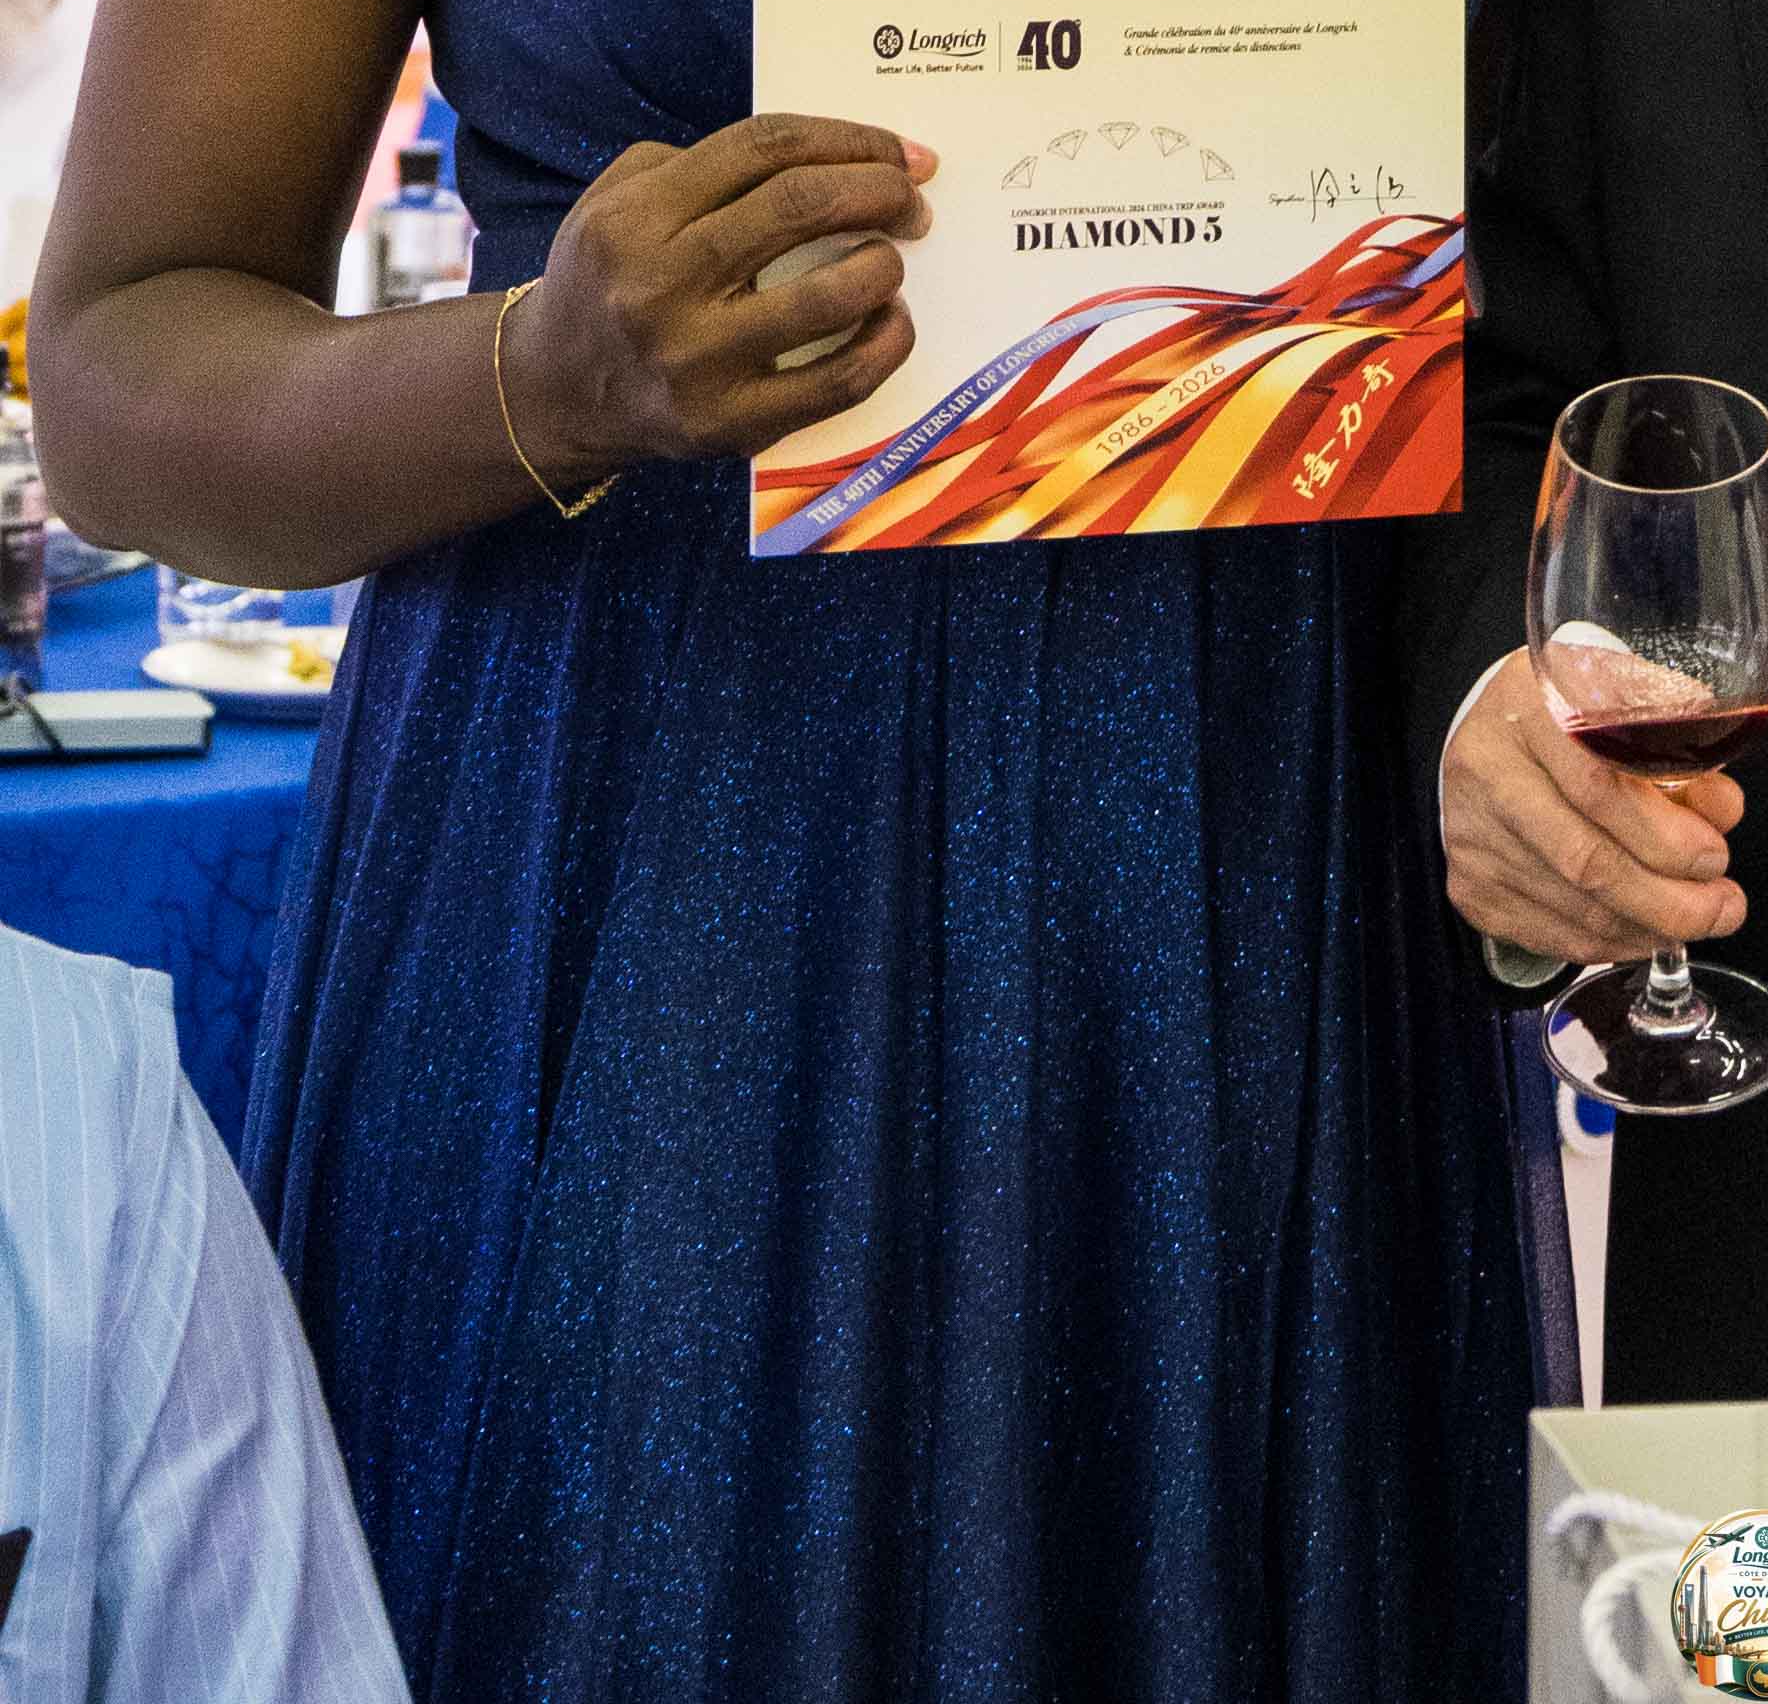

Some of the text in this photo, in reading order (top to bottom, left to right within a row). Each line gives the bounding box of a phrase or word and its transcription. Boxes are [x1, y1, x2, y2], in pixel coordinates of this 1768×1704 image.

[908, 28, 986, 52] Longrich
[1124, 26, 1159, 39] Grande
[1214, 24, 1226, 36] du
[1245, 22, 1301, 35] anniversaire
[1303, 21, 1314, 33] de
[1316, 20, 1358, 35] Longrich
[1016, 19, 1082, 70] 40
[1188, 43, 1198, 54] de
[1233, 41, 1248, 53] des
[876, 65, 903, 75] Better
[926, 63, 951, 73] Better
[955, 63, 984, 72] Future
[1011, 207, 1057, 218] LONGRICH
[1058, 204, 1126, 216] INTERNATIONAL
[1146, 202, 1173, 212] CHINA
[1175, 201, 1194, 211] TRIP
[1196, 200, 1225, 209] AWARD
[1014, 215, 1223, 252] DIAMOND 5
[1096, 413, 1154, 455] 1986
[1170, 361, 1227, 400] 2026
[806, 317, 1081, 525] THE 40TH ANNIVERSARY OF LONGRICH
